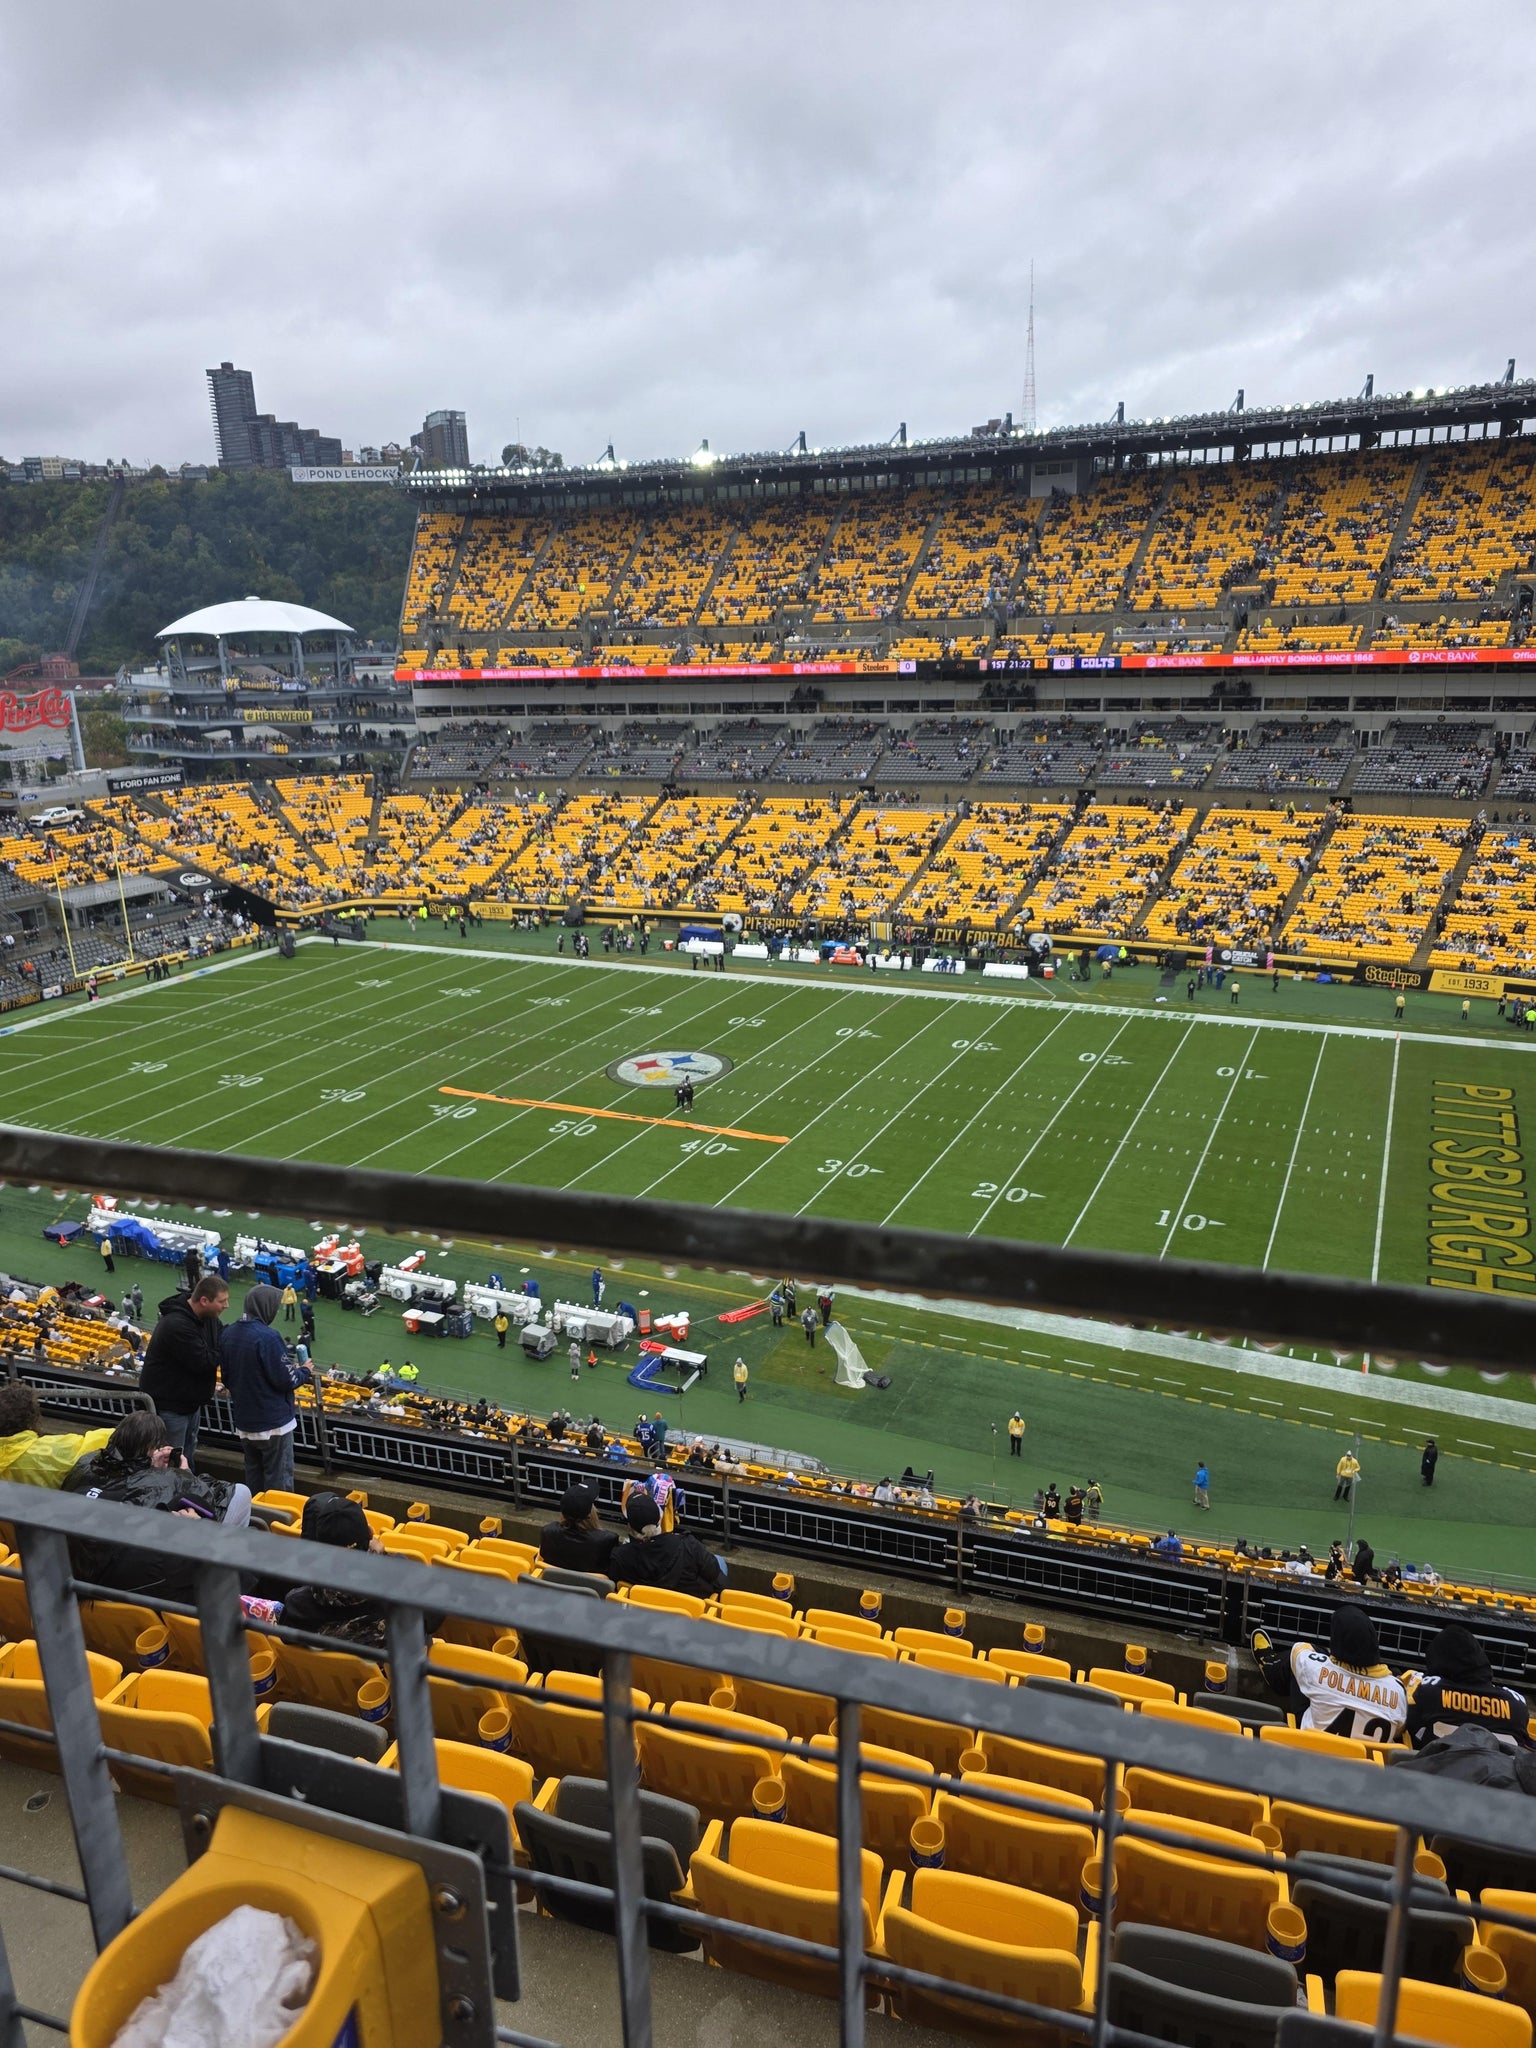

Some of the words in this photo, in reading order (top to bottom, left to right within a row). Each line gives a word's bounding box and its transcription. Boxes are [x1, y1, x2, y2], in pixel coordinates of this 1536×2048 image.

[309, 470, 341, 479] POND
[344, 469, 396, 479] LEHOCKY
[1157, 657, 1177, 666] PNC
[1178, 656, 1205, 665] BANK
[1233, 655, 1285, 664] BRILLIANTLY
[1287, 654, 1322, 663] BORING
[1324, 654, 1351, 662] SINCE
[1353, 653, 1375, 662] 1865
[1422, 652, 1446, 662] PNC
[1447, 651, 1479, 661] BANK
[802, 664, 820, 672] PNC
[820, 664, 841, 672] BANK
[862, 662, 889, 672] Steelers
[991, 660, 1006, 669] 1ST
[1009, 659, 1031, 668] 21:22
[1081, 658, 1115, 668] COLTS
[120, 779, 142, 789] FORD
[143, 777, 160, 786] FAN
[160, 774, 181, 784] ZONE
[489, 906, 504, 914] 1933
[1232, 950, 1258, 959] CRUCIAL
[1365, 965, 1421, 986] Steelers
[1463, 978, 1489, 990] 1933
[727, 1016, 766, 1028] 50
[951, 1039, 993, 1051] 30
[1078, 1052, 1123, 1065] 20
[128, 1061, 168, 1073] 10
[1216, 1066, 1257, 1079] 10
[217, 1074, 264, 1087] 20
[320, 1089, 366, 1103] 30
[431, 1104, 477, 1119] 40
[548, 1120, 598, 1137] 50
[679, 1139, 728, 1156] 40
[816, 1159, 870, 1178] 30
[971, 1182, 1030, 1203] 20
[1427, 1080, 1536, 1298] PITTSBURGH
[1155, 1208, 1208, 1232] 10
[678, 1327, 686, 1336] G
[641, 1431, 650, 1440] 15
[1047, 1500, 1057, 1508] 90
[1318, 1666, 1398, 1710] POLAMALU
[1441, 1689, 1511, 1719] WOODSON
